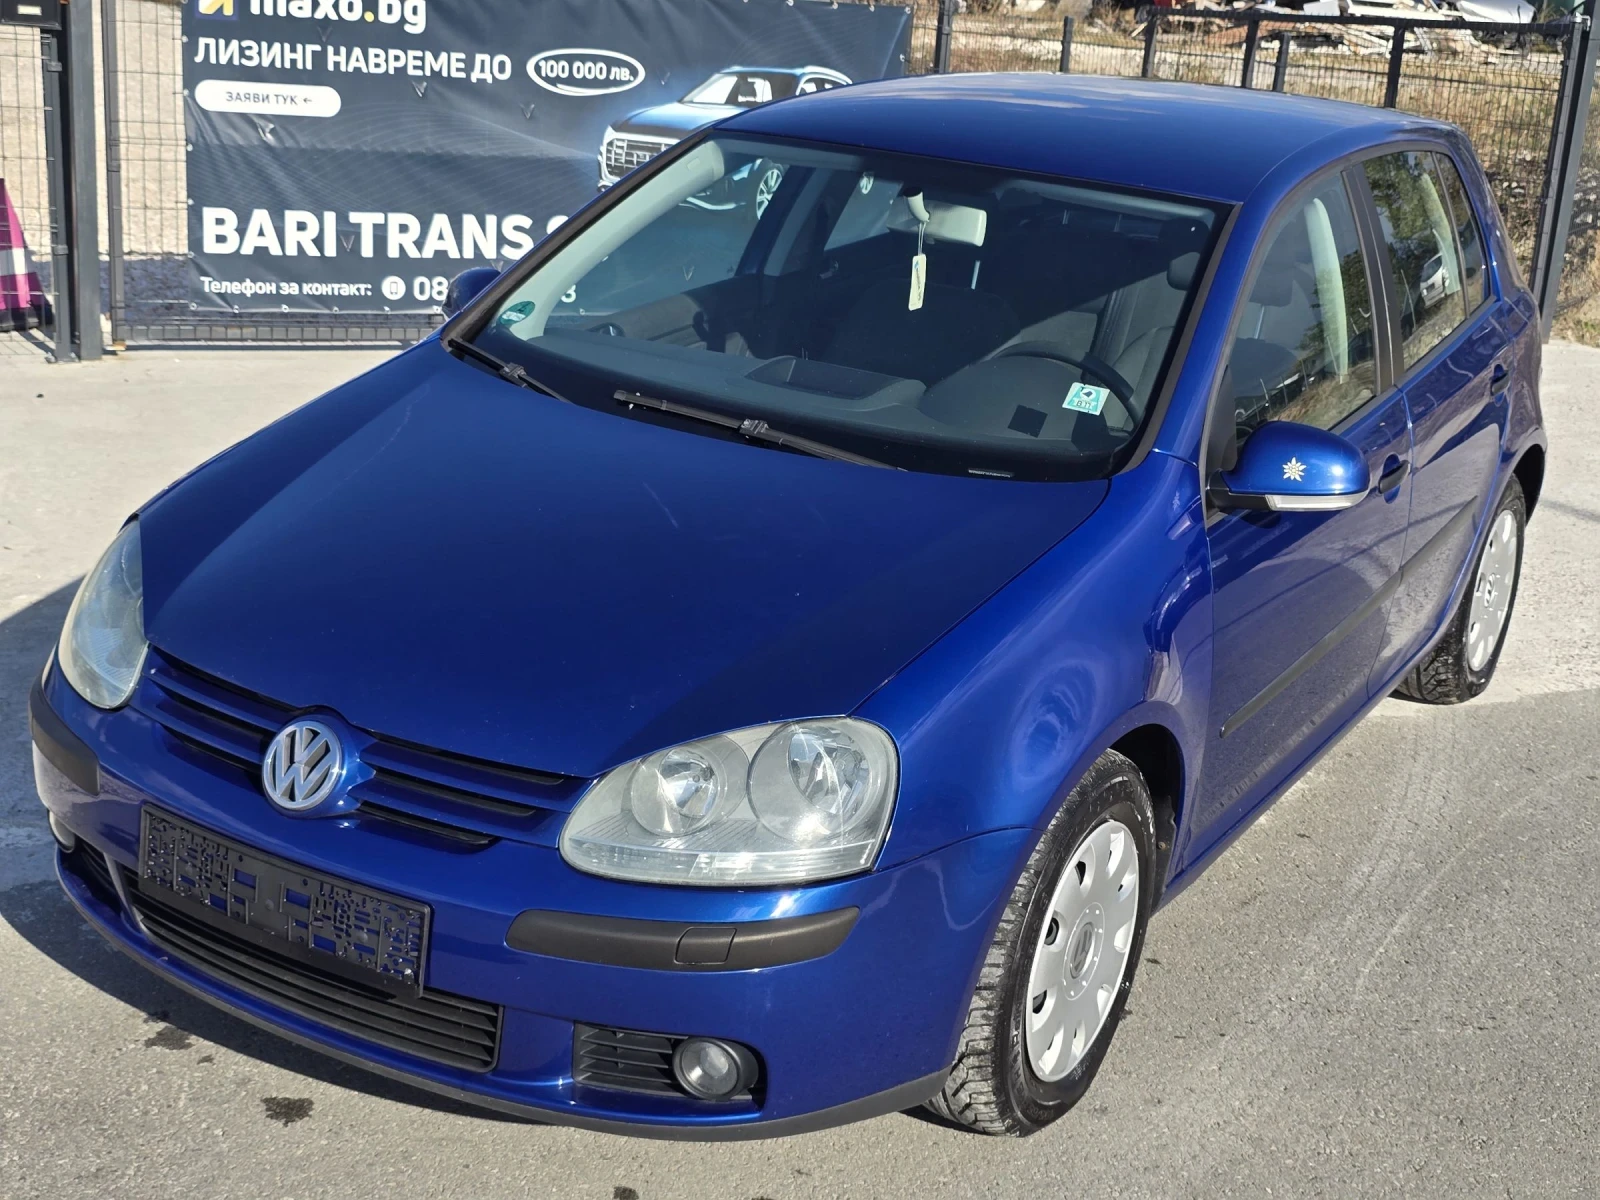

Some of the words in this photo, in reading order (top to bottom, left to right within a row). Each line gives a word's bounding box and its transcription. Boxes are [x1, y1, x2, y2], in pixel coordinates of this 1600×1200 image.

[194, 37, 322, 71] ЛИЗИНГ
[326, 45, 467, 79] НАВРЕМЕ
[470, 53, 512, 84] ДО
[538, 59, 569, 79] 100
[572, 61, 607, 80] 000
[609, 67, 635, 82] лв.
[225, 90, 271, 104] ЗАЯВИ
[275, 92, 299, 105] ТУК
[202, 206, 337, 258] BARI
[348, 211, 535, 261] TRANS
[200, 276, 276, 297] Телефон
[279, 283, 300, 295] за
[301, 282, 373, 296] контакт:
[265, 722, 339, 807] VW
